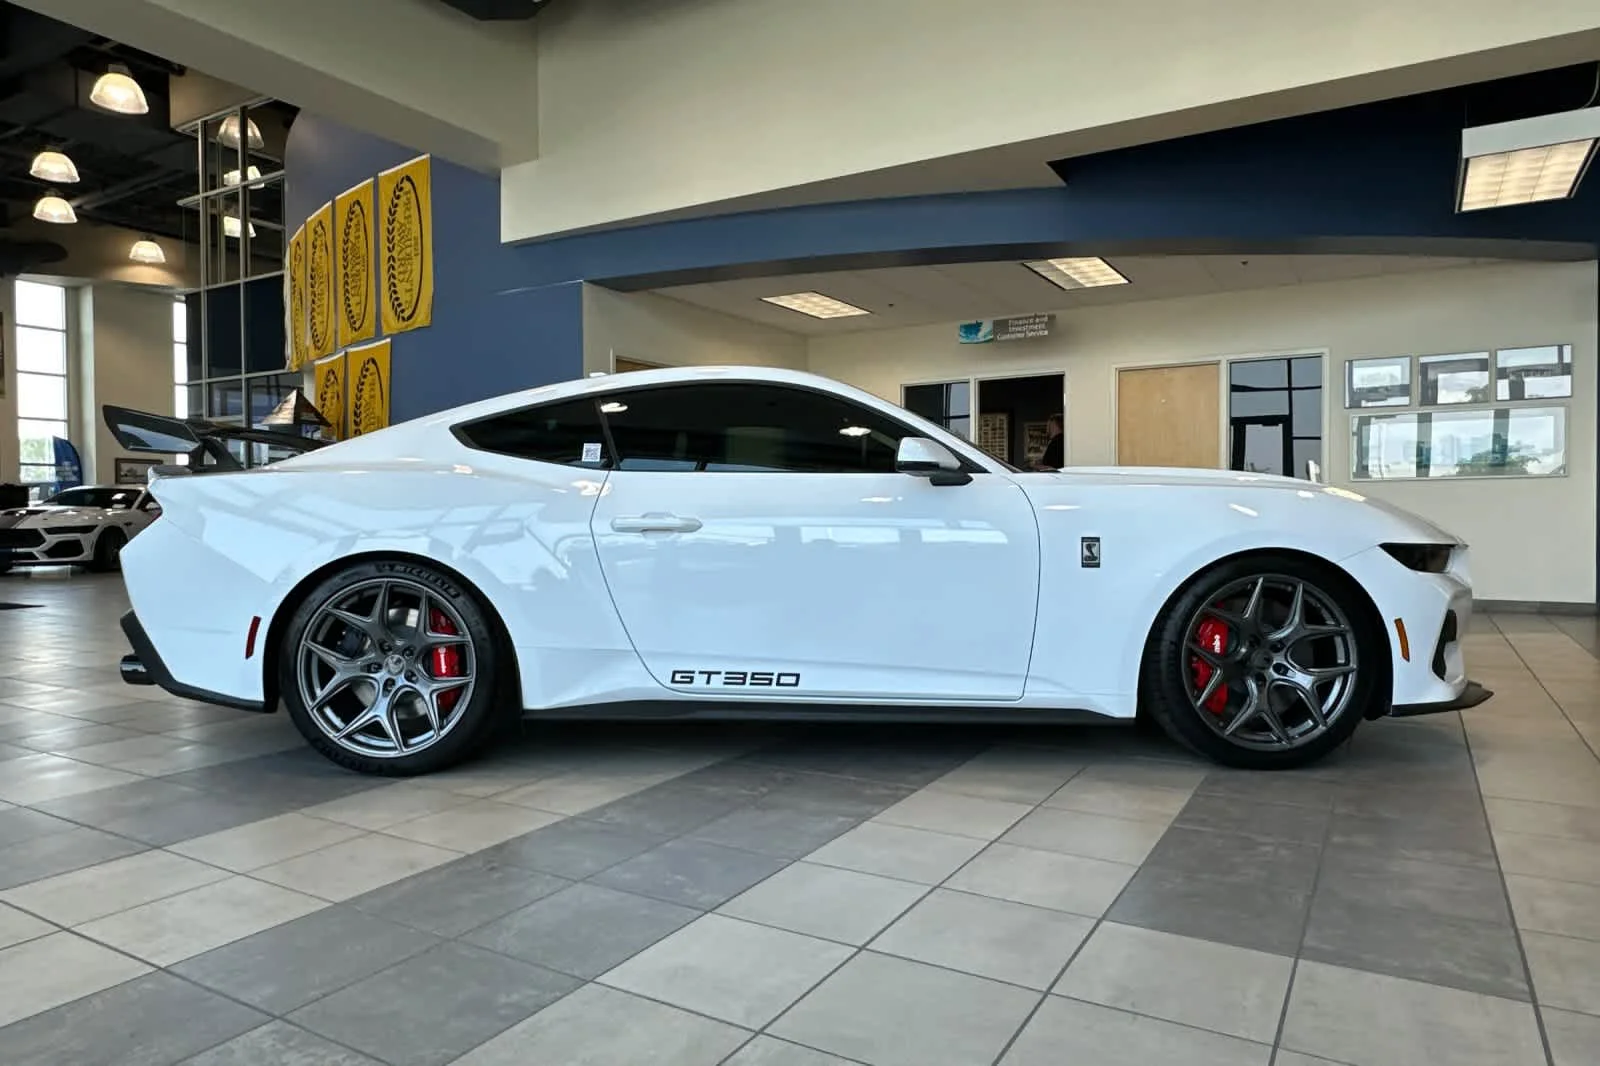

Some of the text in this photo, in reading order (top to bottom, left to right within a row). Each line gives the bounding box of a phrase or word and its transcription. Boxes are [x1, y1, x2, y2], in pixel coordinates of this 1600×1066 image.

[1008, 324, 1046, 332] Investment
[997, 330, 1048, 341] Customer Service
[394, 566, 460, 598] MICHELIN
[670, 670, 801, 687] GT350
